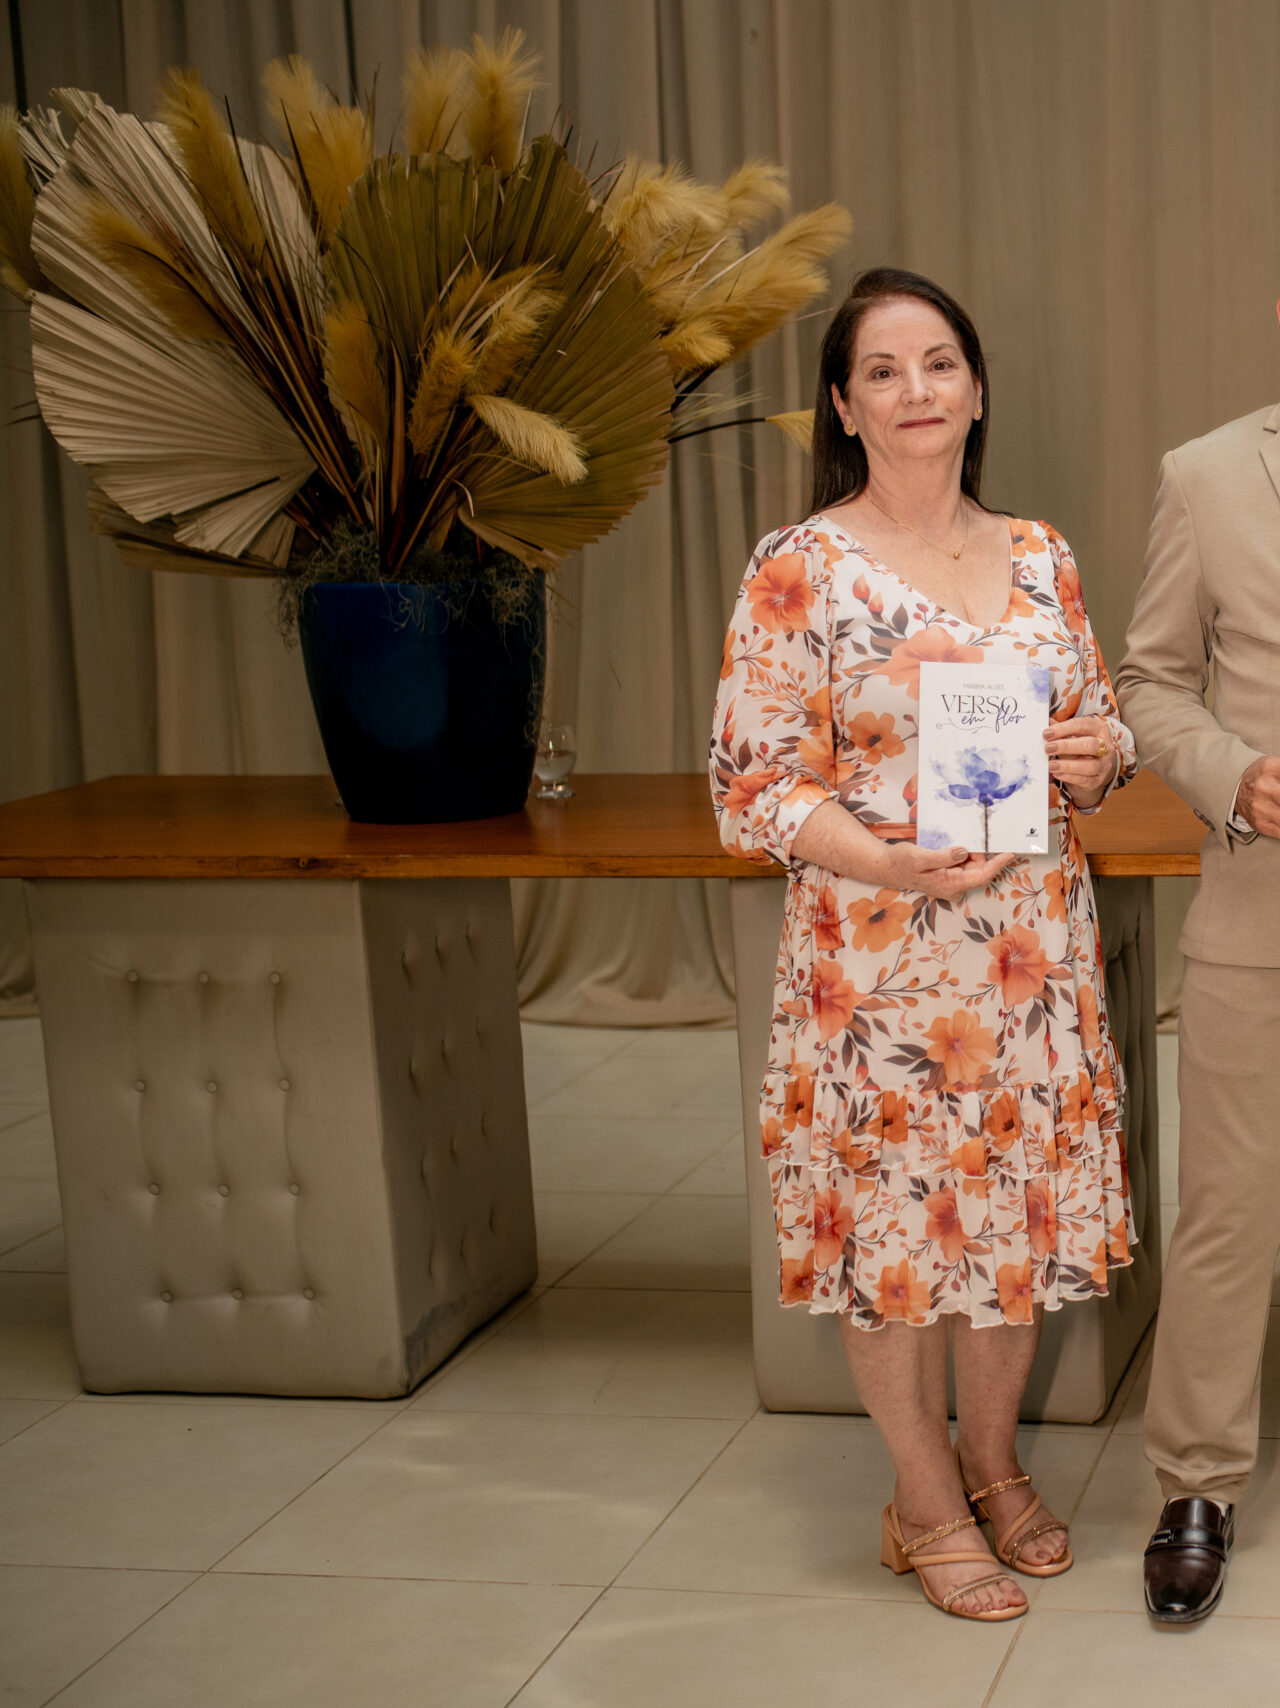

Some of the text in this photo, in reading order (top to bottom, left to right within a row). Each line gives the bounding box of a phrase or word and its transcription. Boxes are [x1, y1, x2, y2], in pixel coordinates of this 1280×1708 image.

[941, 694, 1018, 715] VERSO
[961, 703, 1026, 734] em flor
